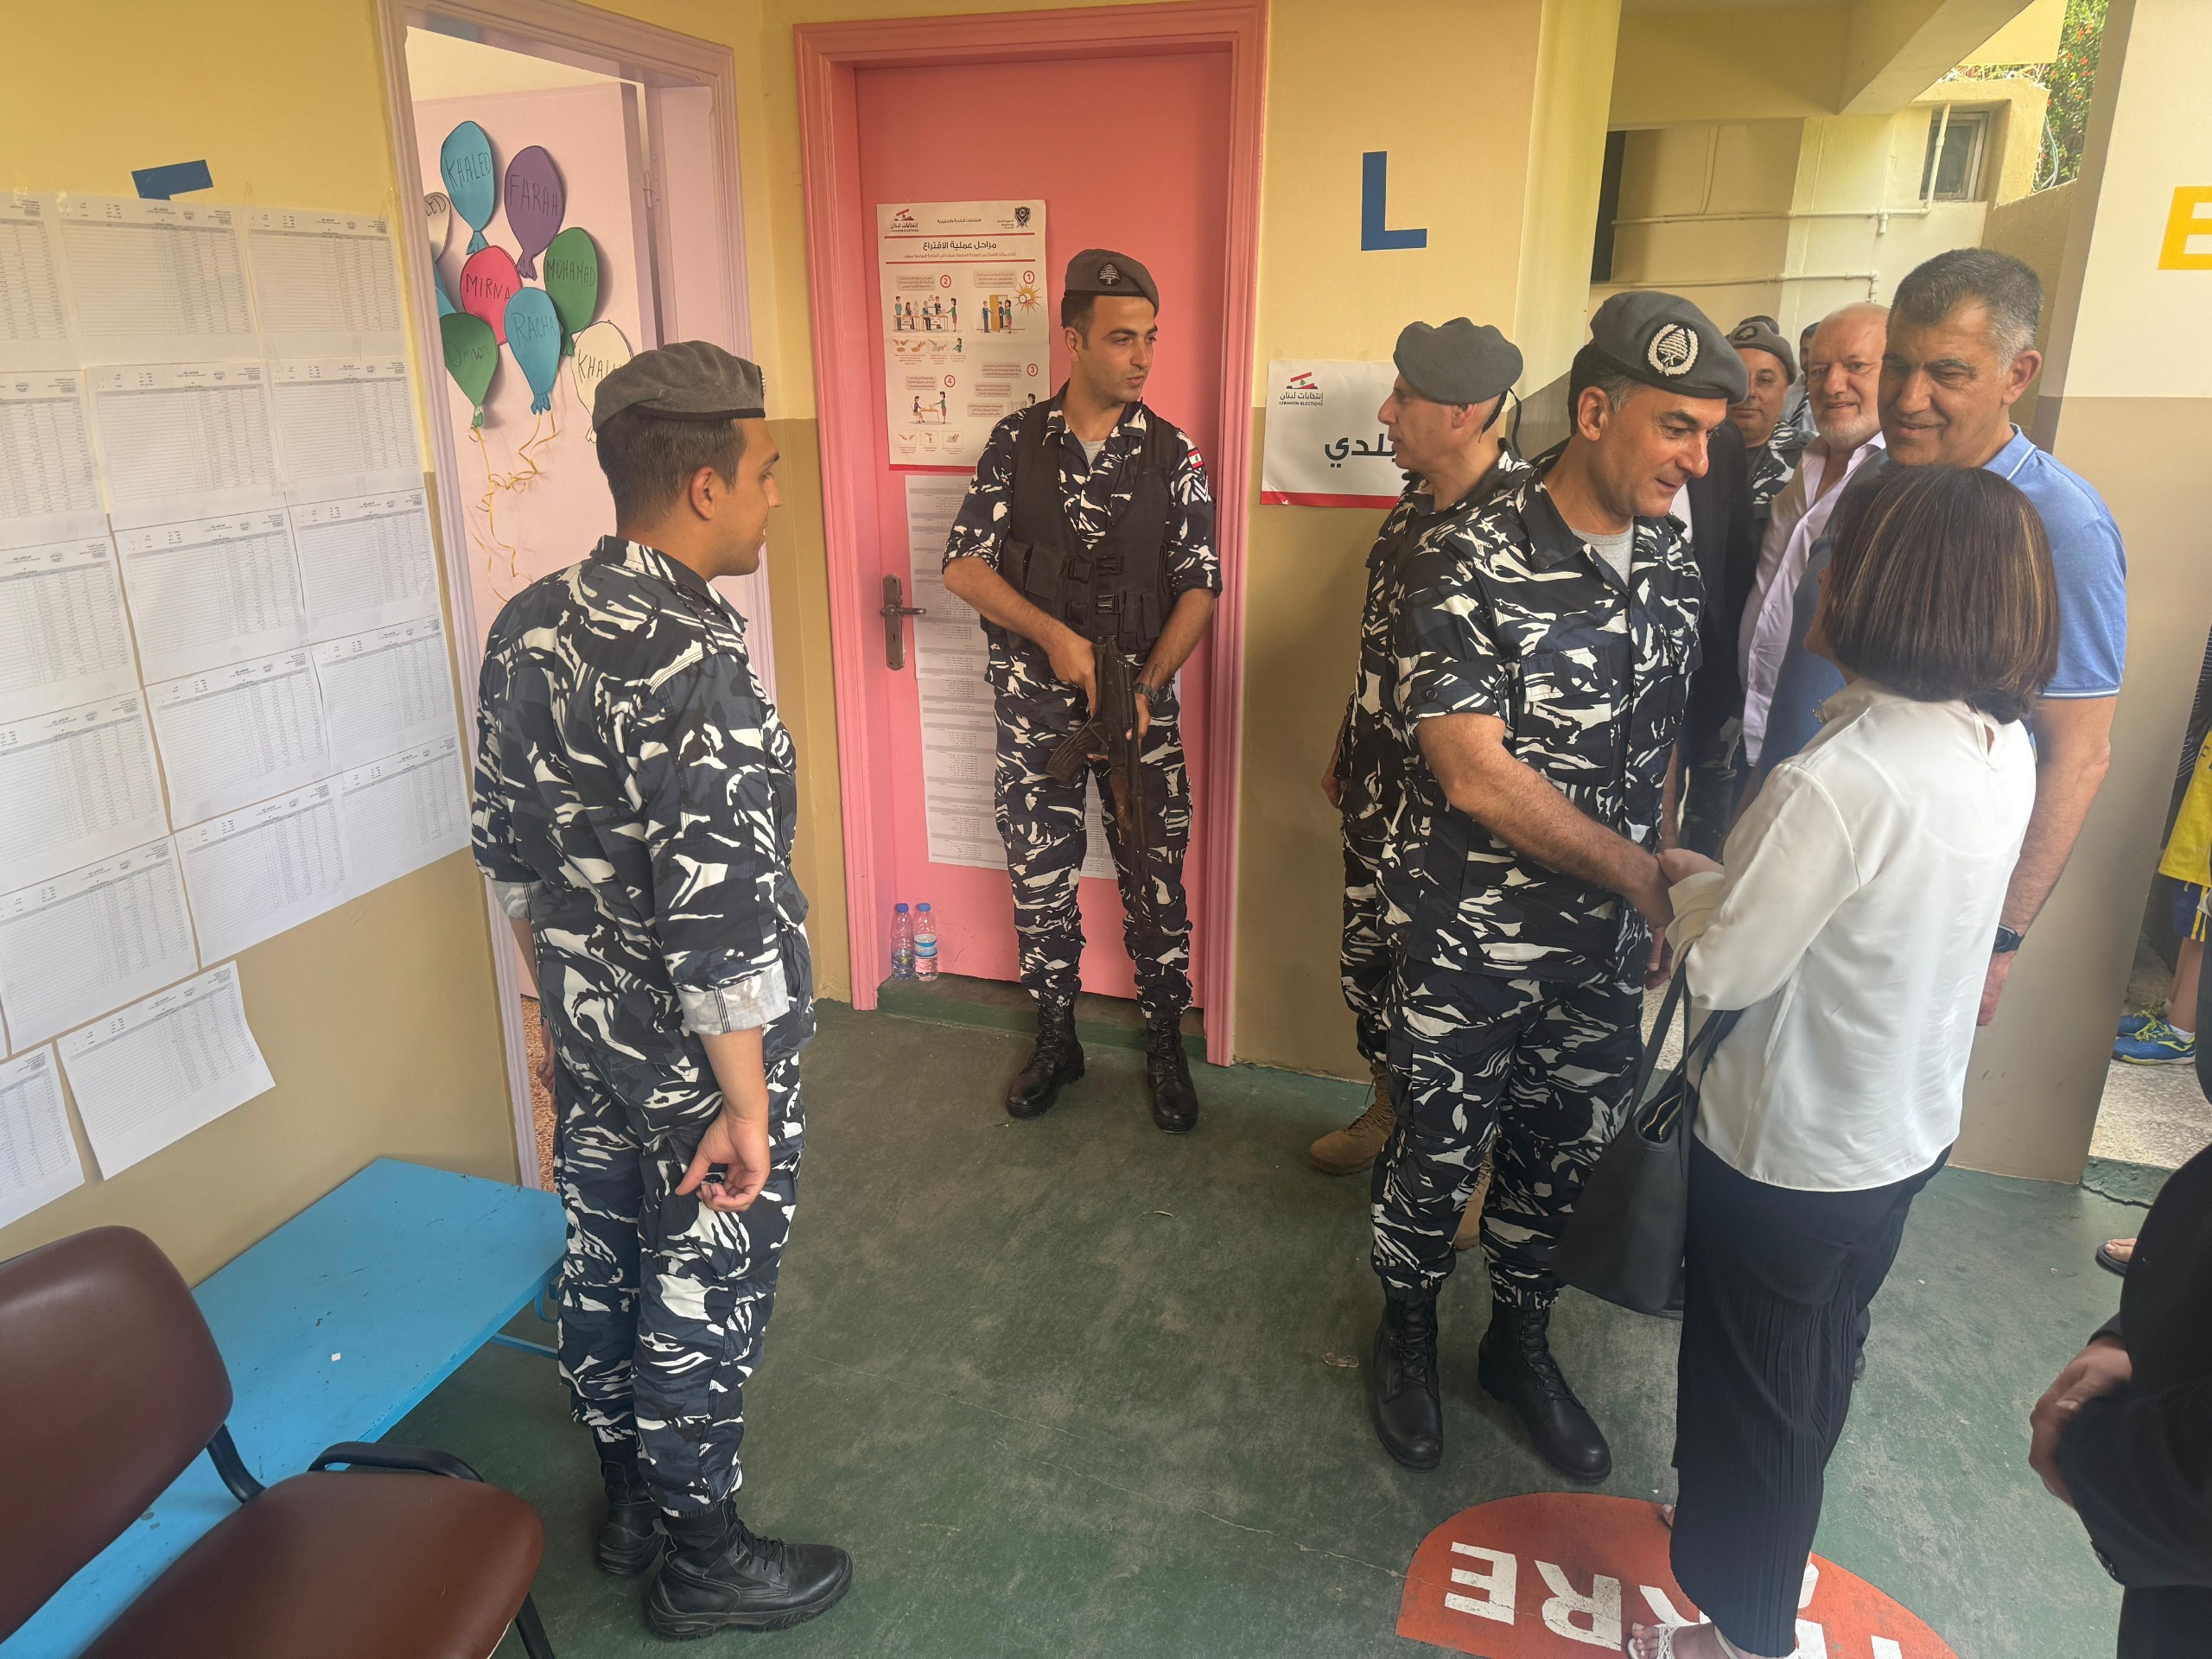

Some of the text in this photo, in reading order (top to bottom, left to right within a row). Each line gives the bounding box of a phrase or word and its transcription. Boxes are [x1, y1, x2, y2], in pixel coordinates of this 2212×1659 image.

[444, 151, 492, 192] KHALED
[510, 174, 557, 216] FARAH
[1361, 151, 1427, 251] L
[923, 240, 997, 251] مراحل عملية الاقتراع
[466, 273, 510, 302] MIRNA
[546, 258, 596, 288] MOHAMAD
[511, 312, 557, 346] RACHA
[1279, 391, 1324, 402] إنتخابات لبنان
